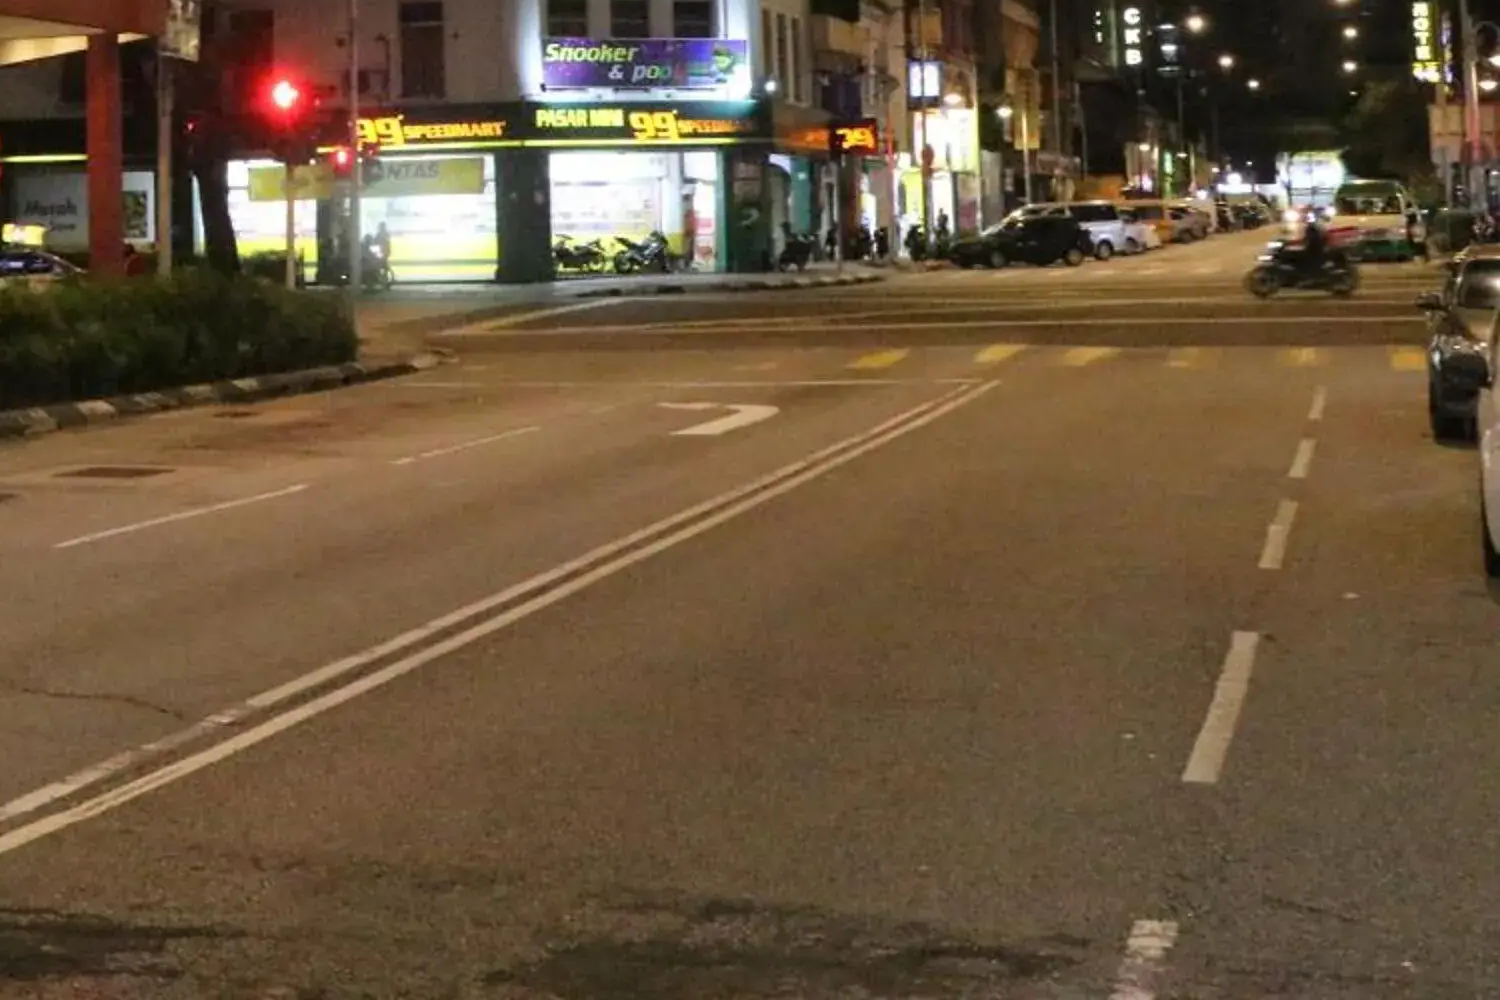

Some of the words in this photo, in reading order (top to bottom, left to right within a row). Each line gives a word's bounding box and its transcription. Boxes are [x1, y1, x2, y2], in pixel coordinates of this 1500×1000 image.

[545, 43, 640, 62] Snooker
[608, 65, 624, 80] &
[356, 115, 404, 150] 99
[403, 121, 506, 139] SPEEDMART
[536, 109, 587, 127] PASAR
[629, 110, 679, 141] 99
